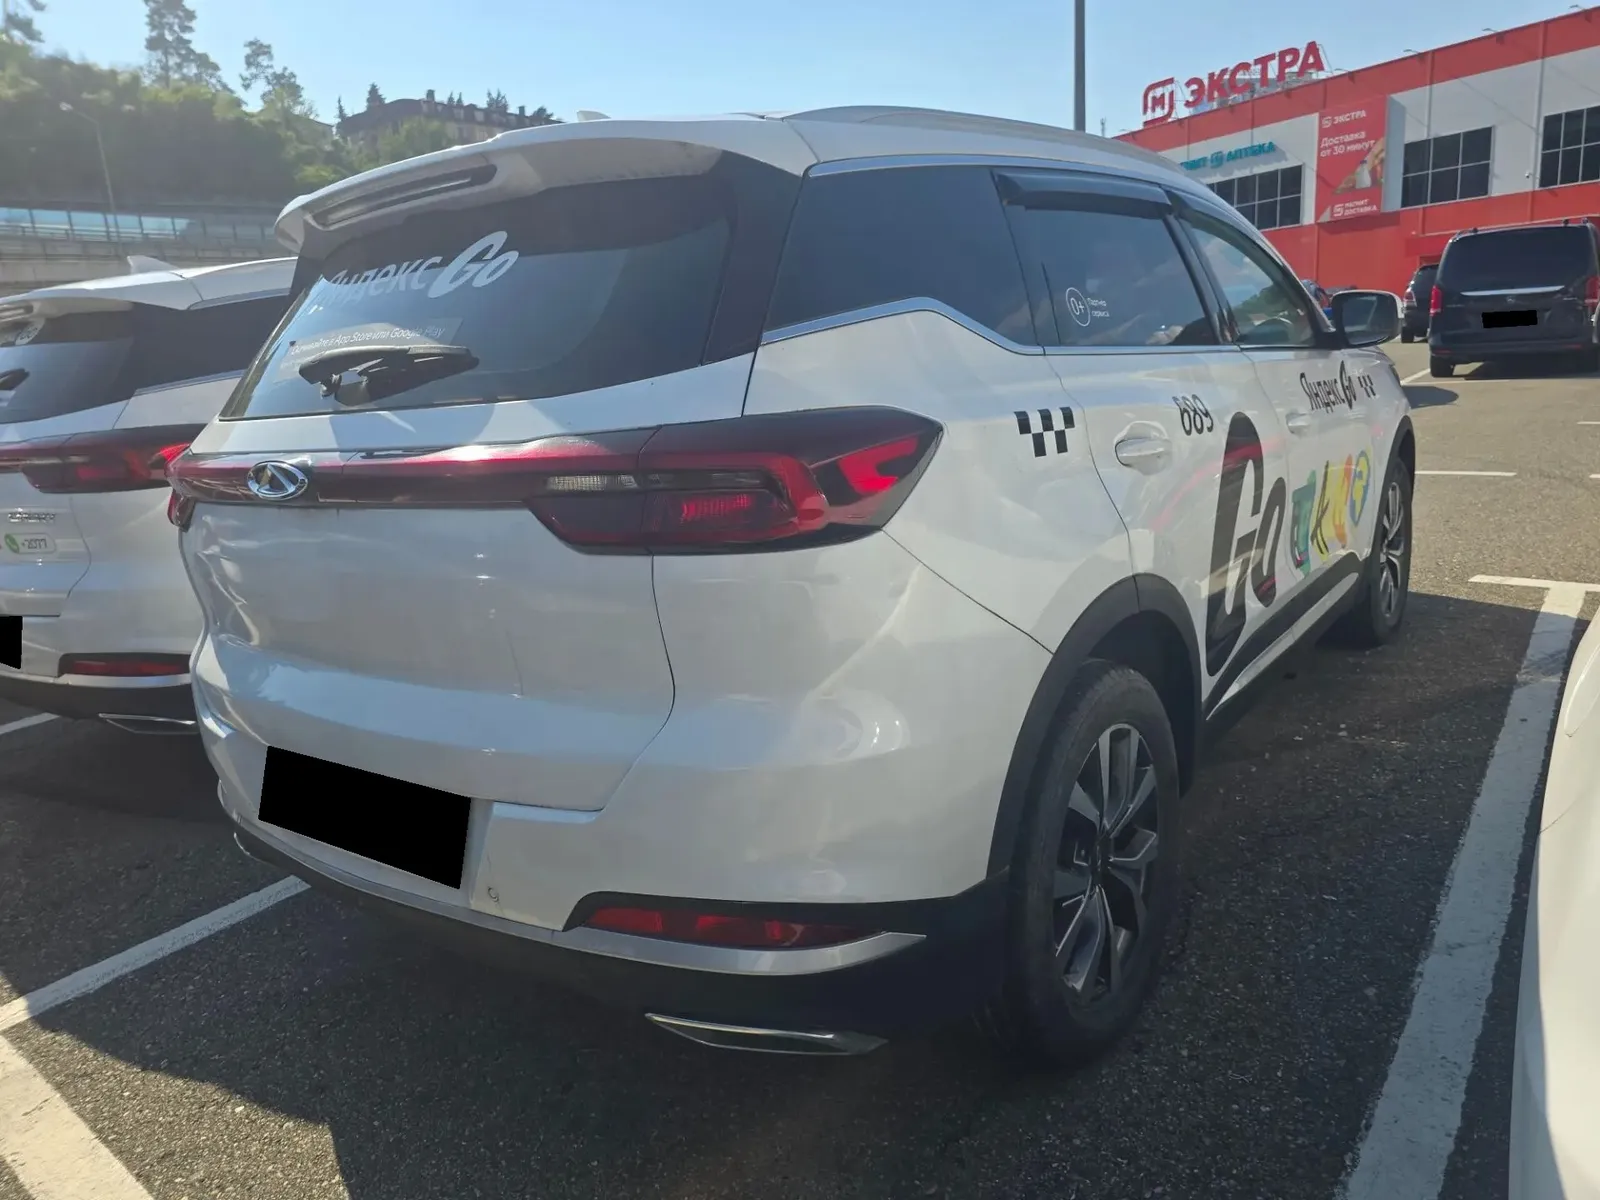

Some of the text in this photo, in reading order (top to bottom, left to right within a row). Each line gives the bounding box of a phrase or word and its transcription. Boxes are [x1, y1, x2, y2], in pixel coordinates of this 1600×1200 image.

[1184, 41, 1325, 109] ЭКСТРА
[1320, 131, 1365, 149] Доставка
[1333, 144, 1346, 155] 30
[427, 231, 520, 298] Go
[335, 334, 351, 346] App
[350, 331, 373, 342] Store
[1300, 360, 1357, 414] Яндекс Go
[1172, 394, 1214, 436] 689
[1205, 411, 1287, 677] Go
